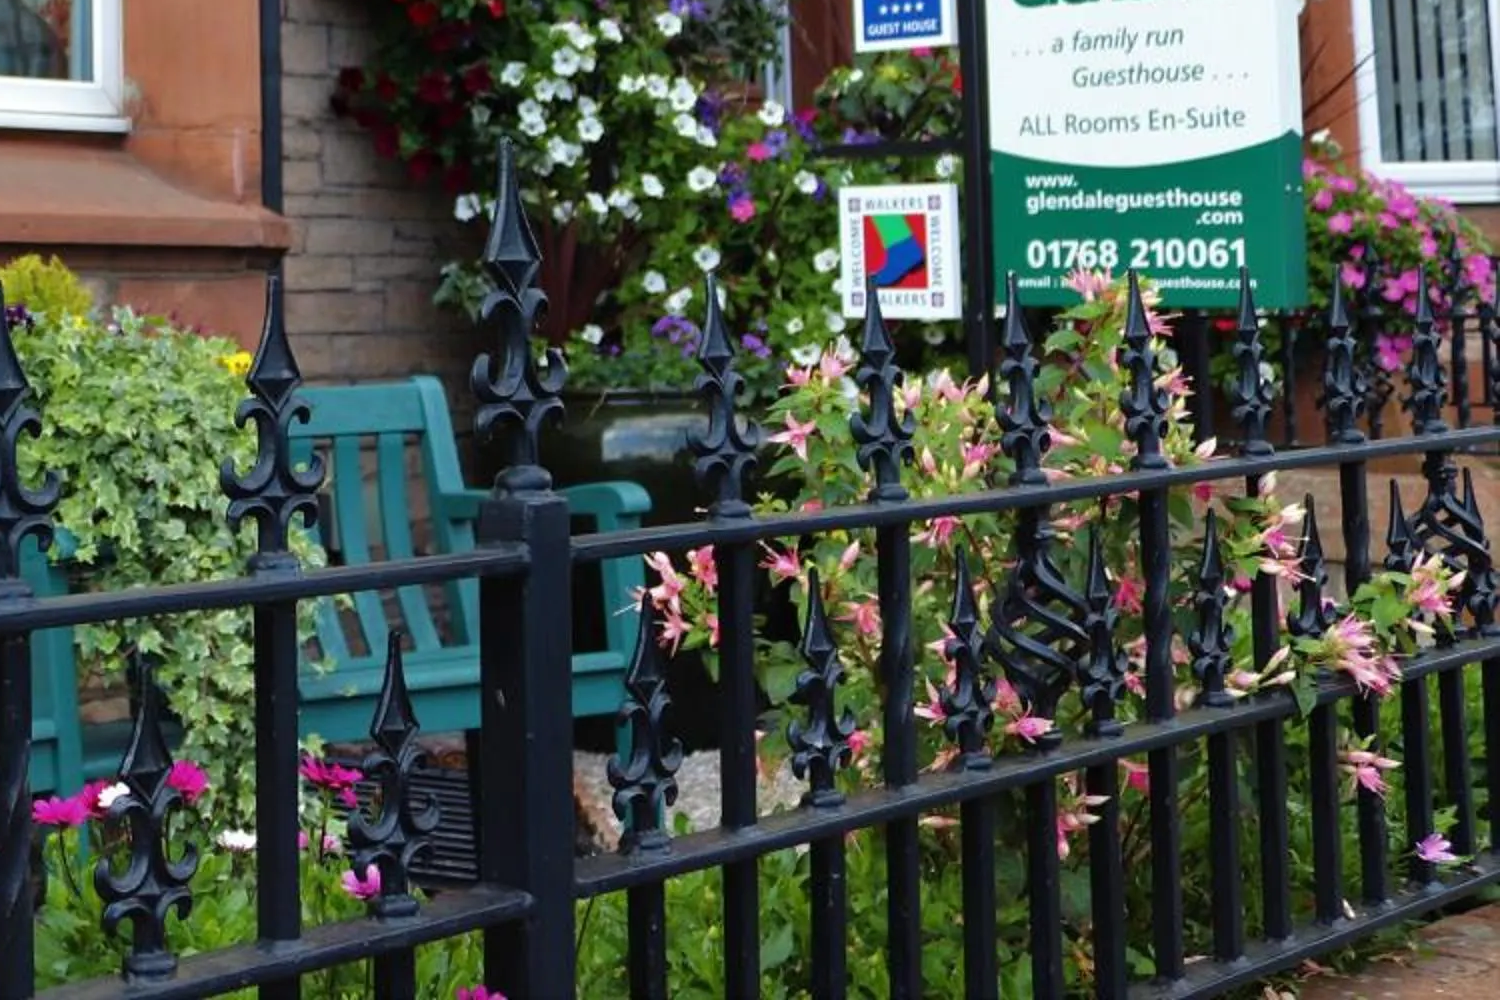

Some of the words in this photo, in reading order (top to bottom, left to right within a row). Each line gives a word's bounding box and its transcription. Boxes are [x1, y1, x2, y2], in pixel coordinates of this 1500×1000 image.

[867, 21, 899, 36] GUEST
[903, 18, 938, 34] HOUSE
[1072, 27, 1139, 56] family
[1145, 27, 1184, 47] run
[1072, 62, 1205, 89] Guesthouse
[1019, 113, 1057, 137] ALL
[1065, 112, 1140, 135] Rooms
[1148, 106, 1246, 132] En-Suite
[1025, 173, 1078, 189] www.
[865, 196, 924, 210] WALKERS
[1025, 188, 1243, 215] glendaleguesthouse
[1195, 209, 1244, 226] .com
[850, 217, 862, 288] WELCOME
[930, 215, 943, 286] WELCOME
[1027, 238, 1119, 269] 01768
[1130, 237, 1246, 268] 210061
[1017, 276, 1051, 288] email
[880, 293, 928, 306] ALKERS
